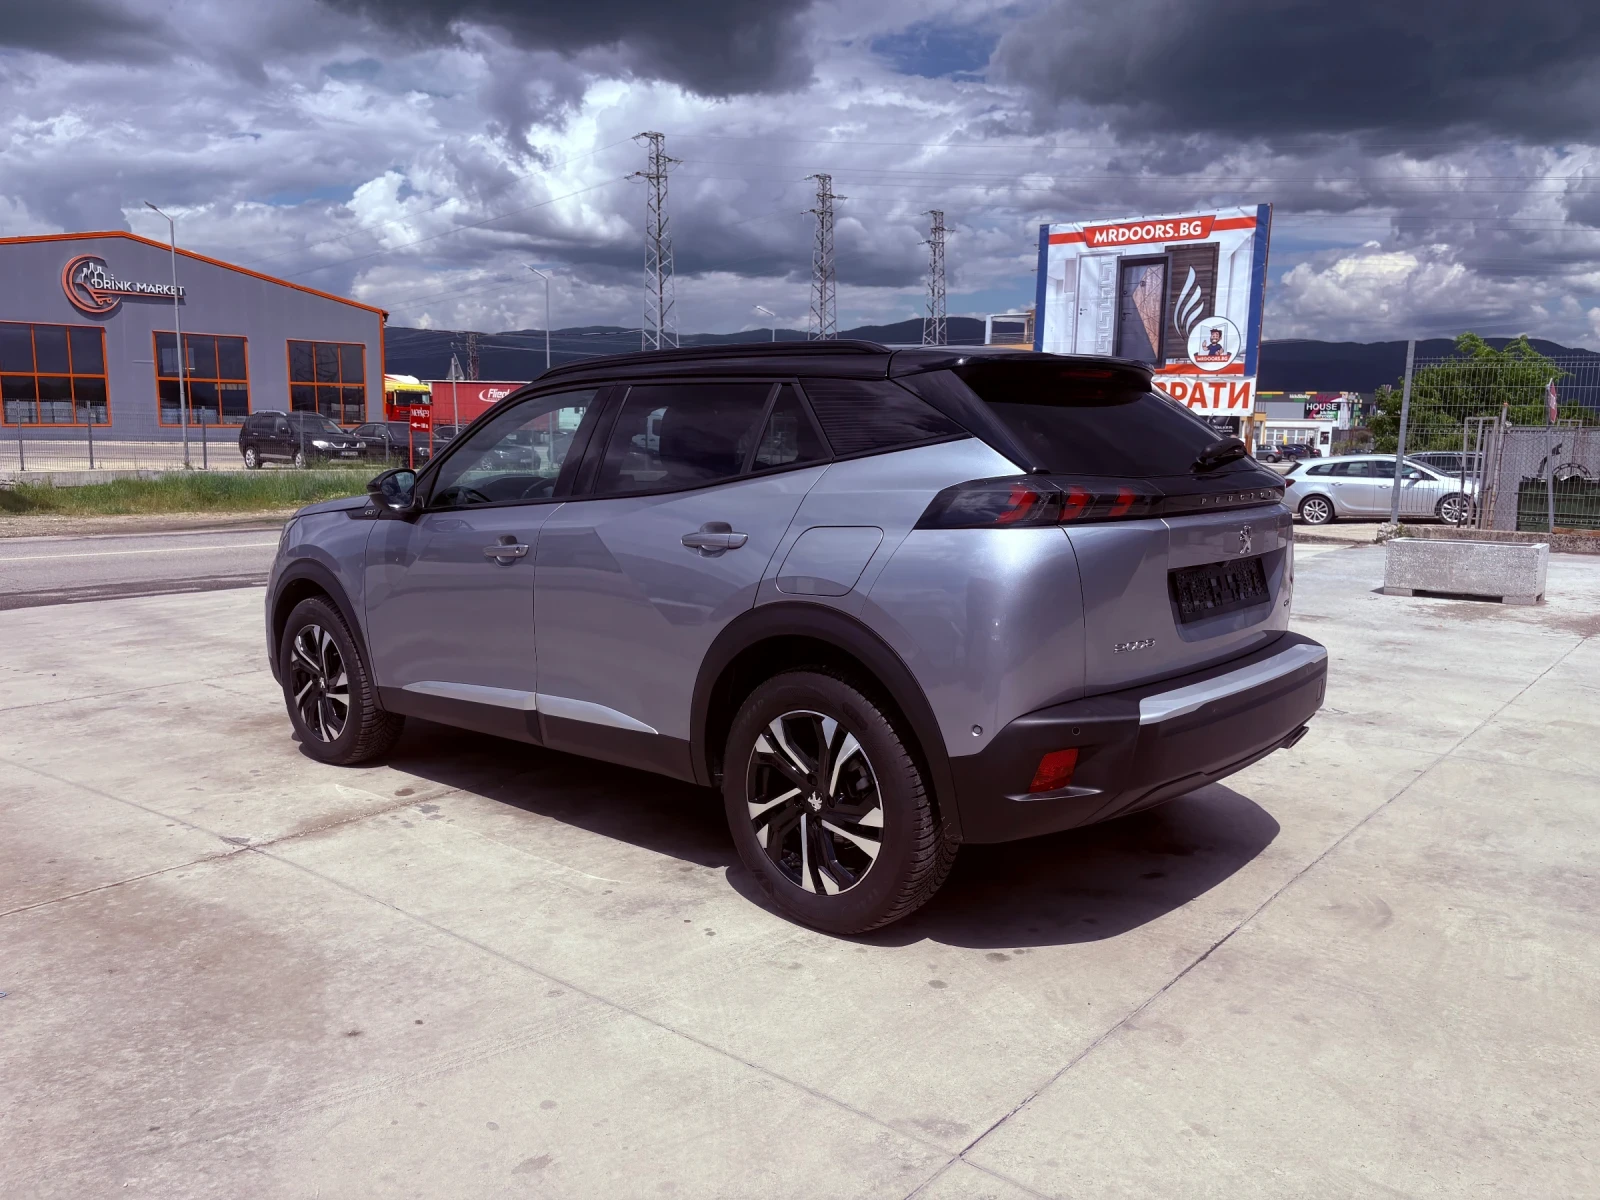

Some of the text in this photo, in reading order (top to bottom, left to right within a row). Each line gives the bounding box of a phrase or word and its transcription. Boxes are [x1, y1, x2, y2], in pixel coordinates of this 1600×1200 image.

[1093, 220, 1203, 244] MRDOORS.BG
[91, 275, 185, 296] DRINK MARKET
